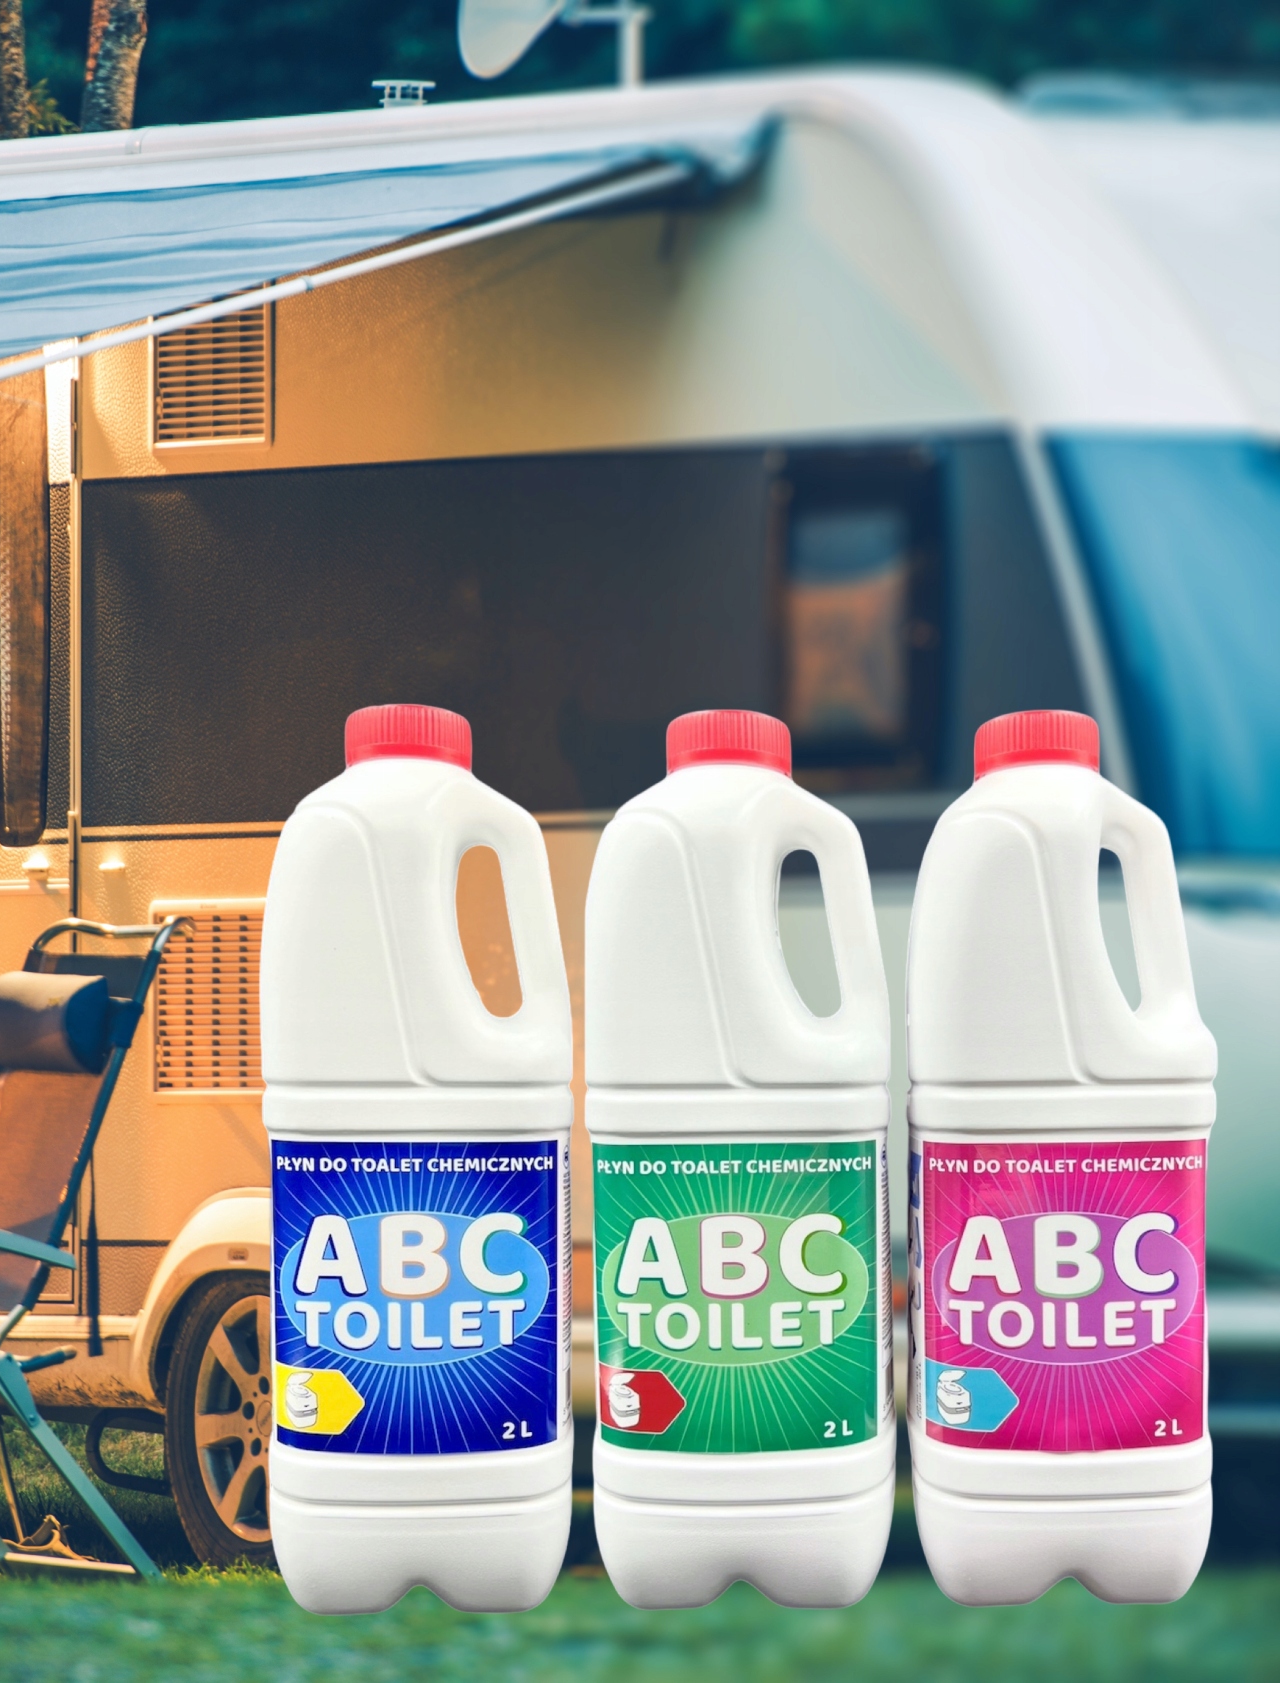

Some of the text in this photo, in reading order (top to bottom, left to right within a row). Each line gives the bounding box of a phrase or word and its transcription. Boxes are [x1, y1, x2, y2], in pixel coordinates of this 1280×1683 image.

[276, 1155, 553, 1172] PŁYN DO TOALET CHEMICZNYCH
[597, 1156, 872, 1175] PŁYN DO TOALET CHEMICZNYCH
[929, 1155, 1203, 1174] PŁYN DO TOALET CHEMICZNYCH
[294, 1212, 528, 1297] ABC
[616, 1212, 847, 1298] ABC
[946, 1212, 1179, 1297] ABC
[294, 1299, 526, 1350] TOILET
[616, 1299, 846, 1350] TOILET
[948, 1299, 1177, 1349] TOILET
